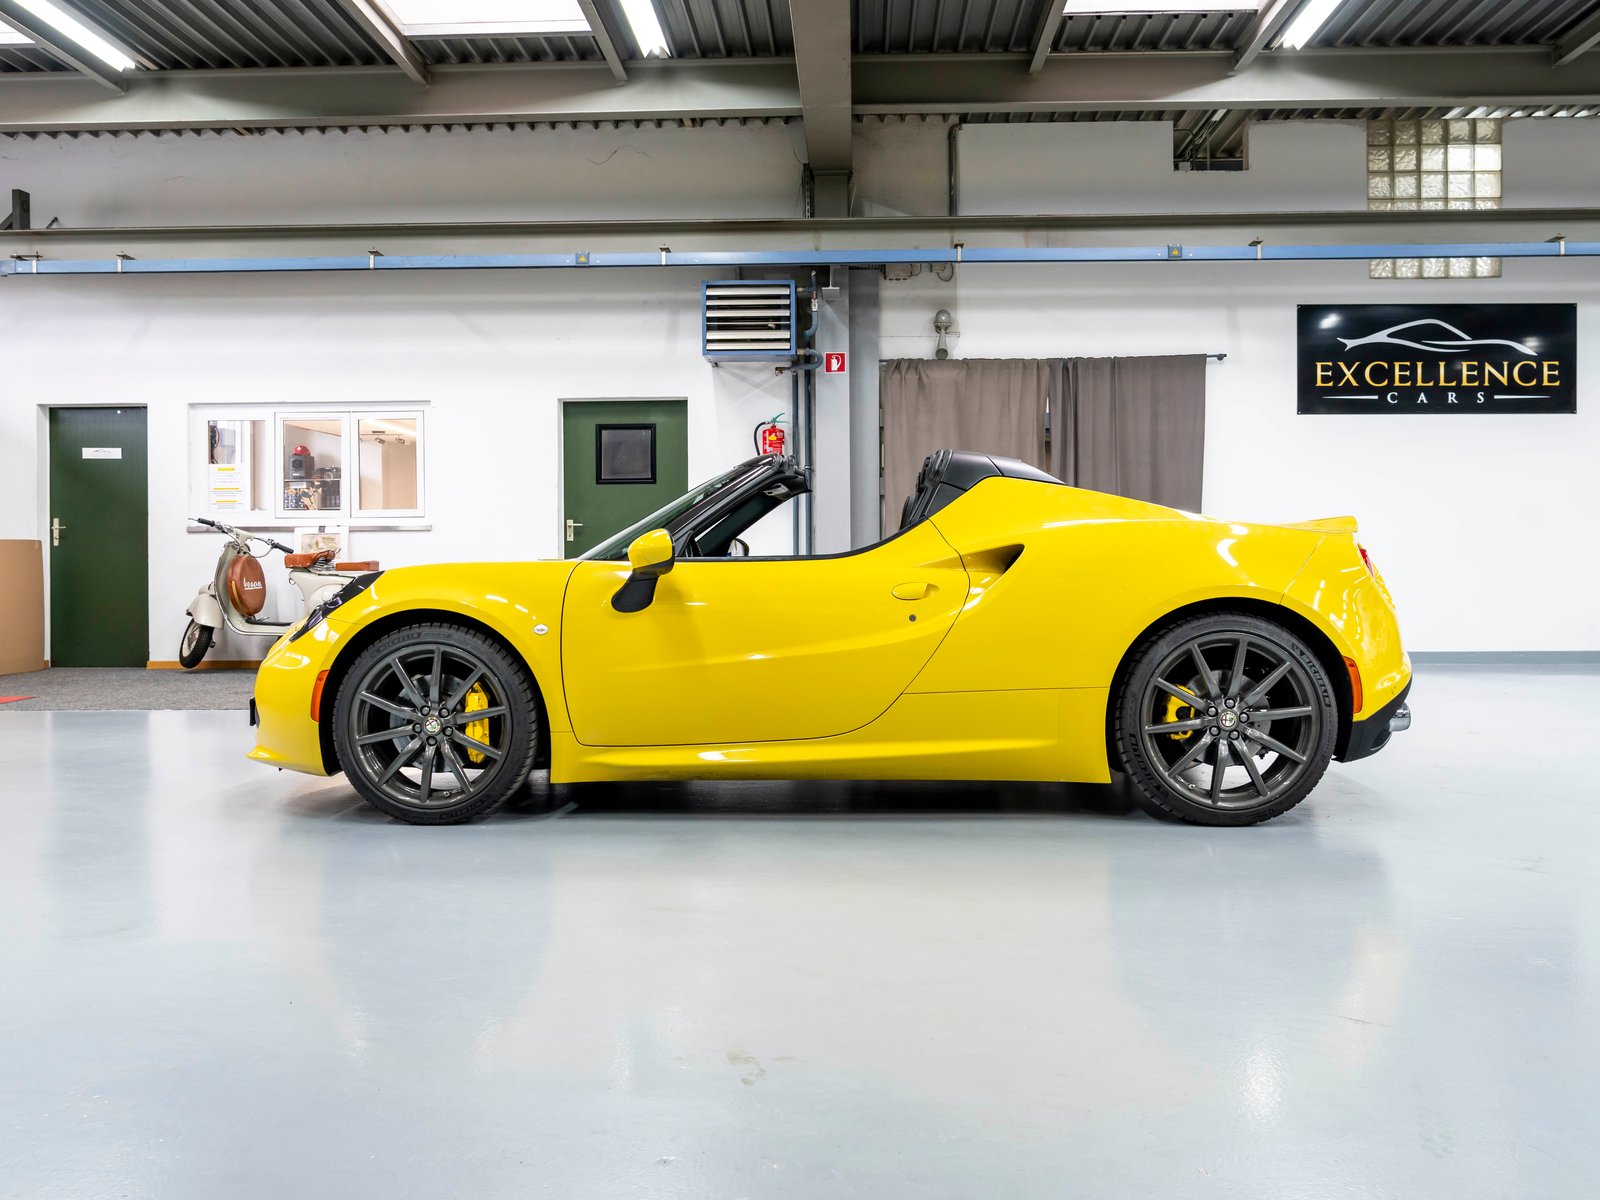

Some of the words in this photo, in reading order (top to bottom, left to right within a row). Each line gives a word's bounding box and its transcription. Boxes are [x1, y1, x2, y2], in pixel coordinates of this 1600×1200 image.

[1315, 360, 1561, 387] EXCELLENCE
[1387, 391, 1485, 404] CARS
[243, 577, 263, 590] Vespa
[1303, 655, 1331, 706] MICHELIN
